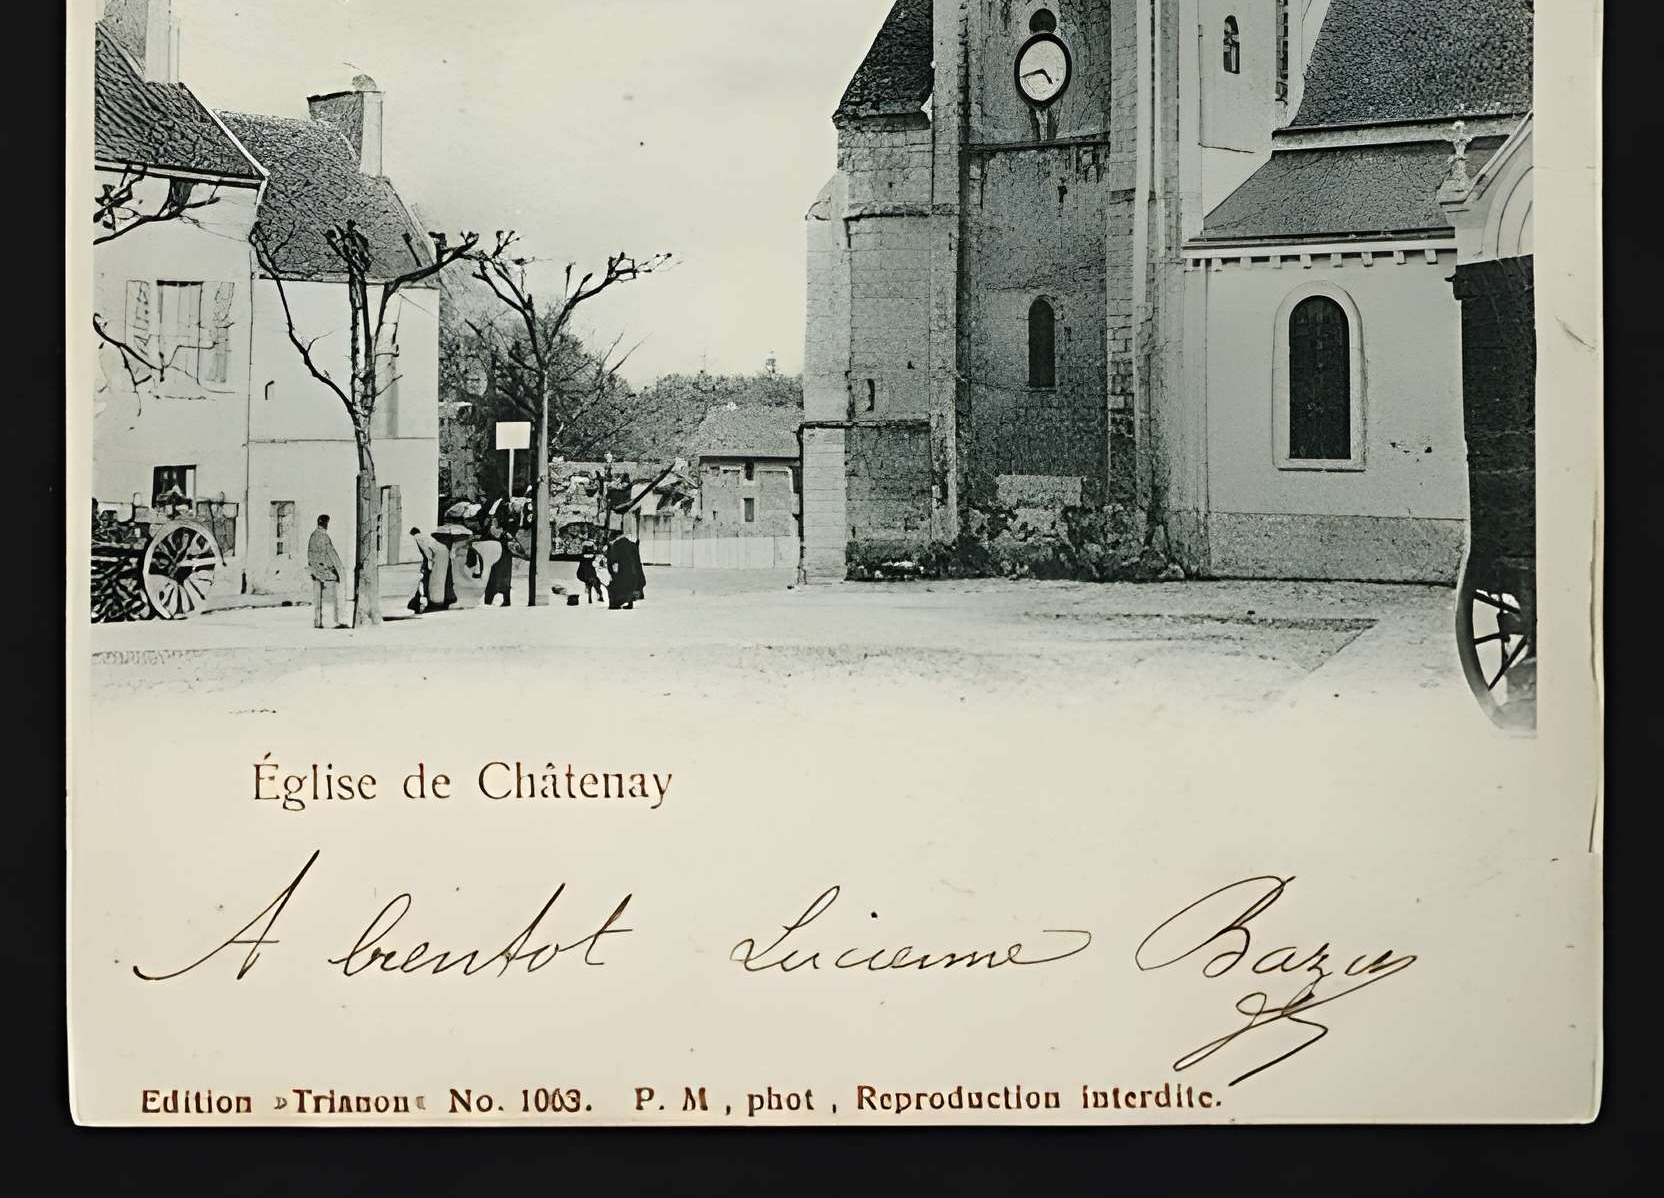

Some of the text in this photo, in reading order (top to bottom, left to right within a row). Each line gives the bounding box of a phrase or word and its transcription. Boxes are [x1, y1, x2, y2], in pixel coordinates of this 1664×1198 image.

[252, 751, 673, 812] Église de Châtenay
[141, 1088, 253, 1115] Edition
[448, 1088, 505, 1114] No.
[634, 1086, 665, 1112] P.
[856, 1084, 1061, 1115] Reproduction
[1082, 1083, 1223, 1111] interdite.
